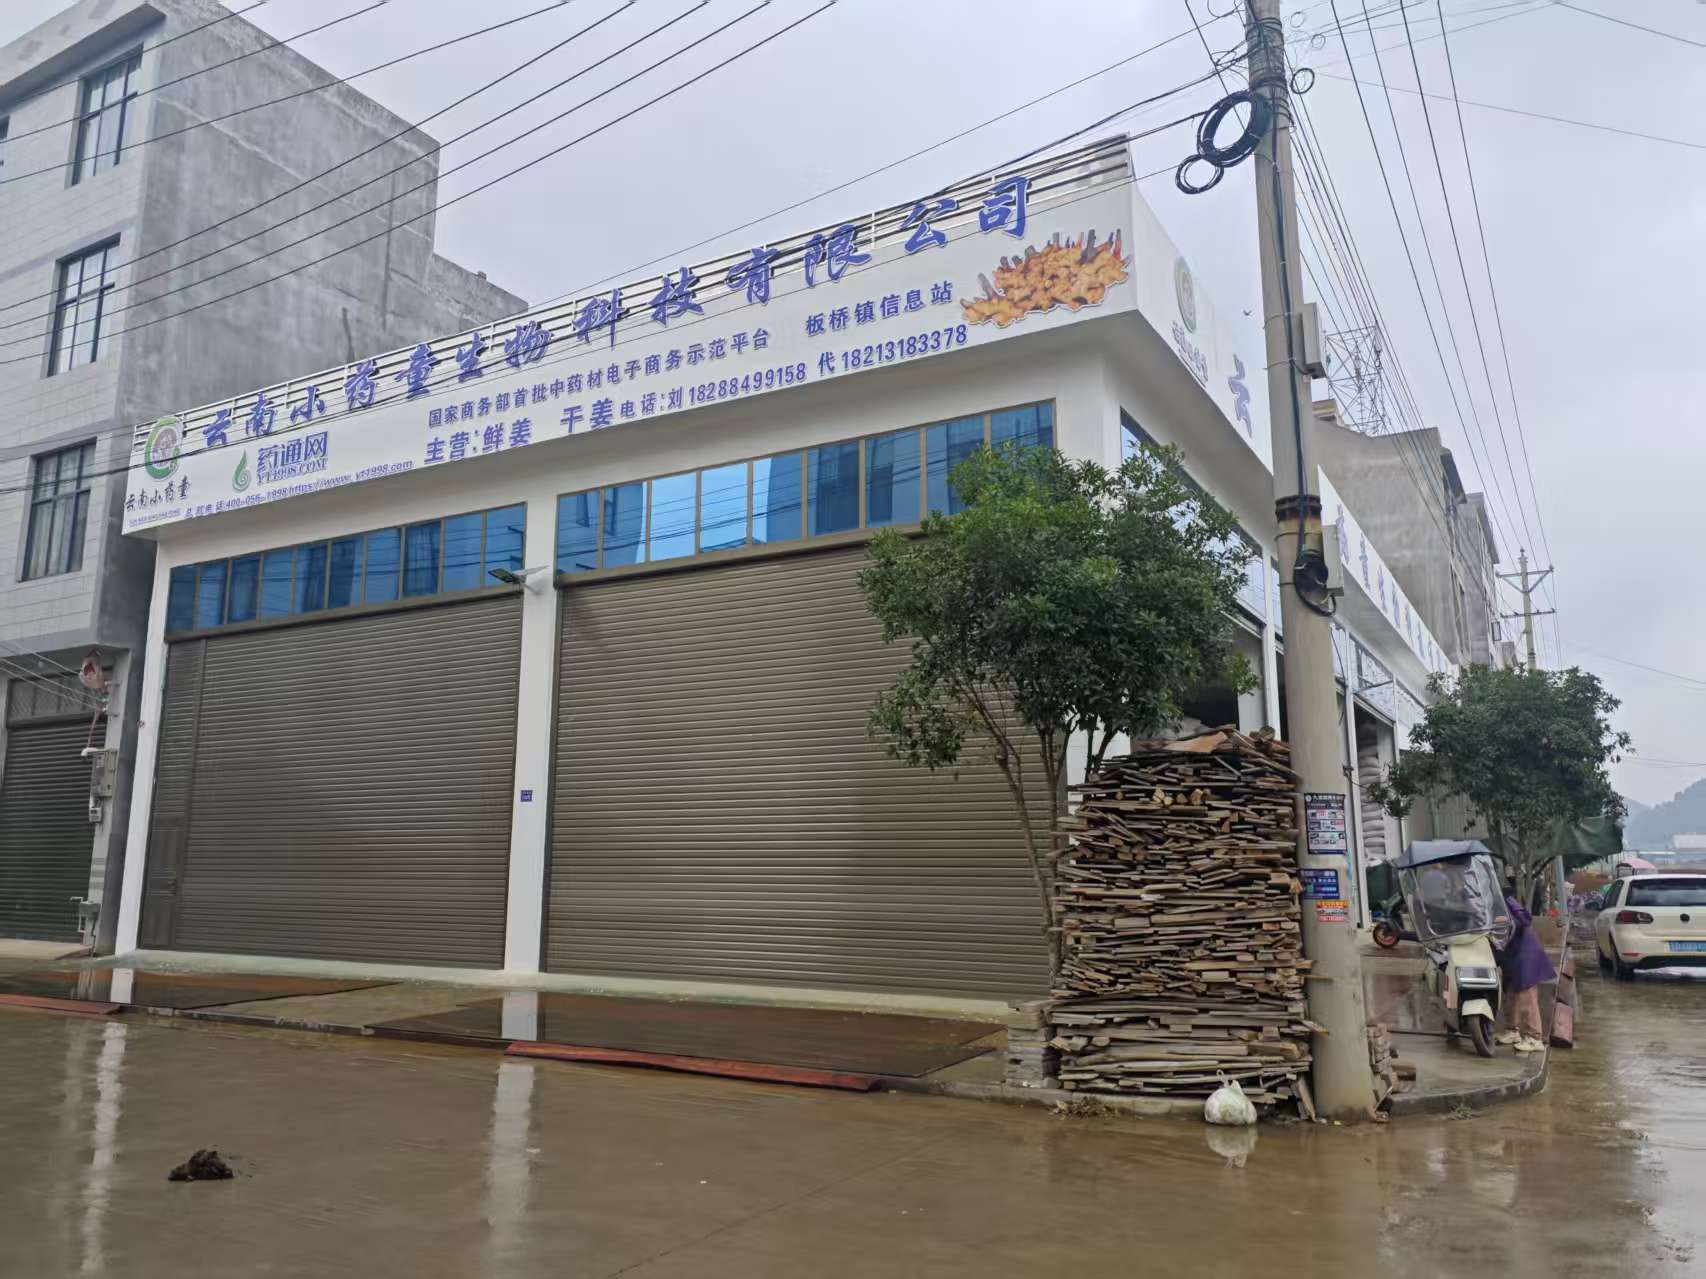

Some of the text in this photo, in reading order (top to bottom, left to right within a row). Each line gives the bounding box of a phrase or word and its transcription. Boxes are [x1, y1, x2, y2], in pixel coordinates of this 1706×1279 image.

[202, 176, 1030, 448] 云南小药童生物科技有限公司
[428, 281, 954, 428] 国家商务部首批中药材电子商务示范平台 板桥镇信息站
[257, 431, 329, 470] 药通网
